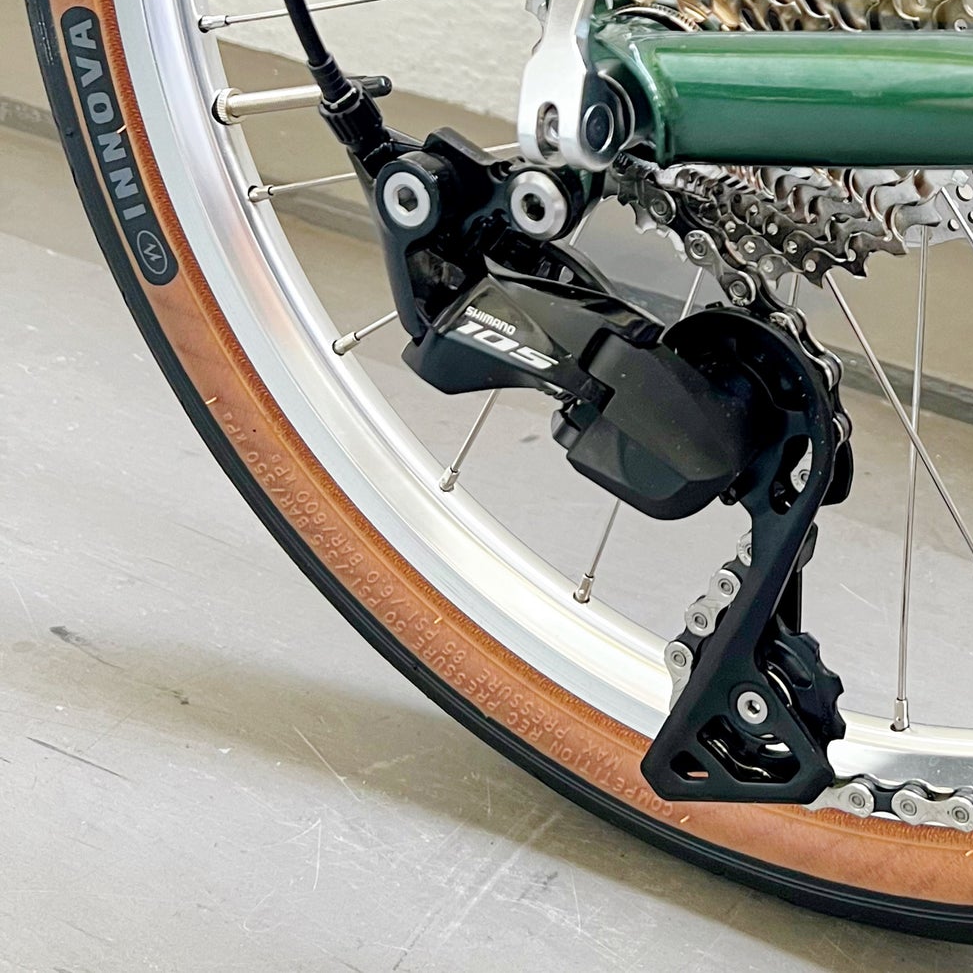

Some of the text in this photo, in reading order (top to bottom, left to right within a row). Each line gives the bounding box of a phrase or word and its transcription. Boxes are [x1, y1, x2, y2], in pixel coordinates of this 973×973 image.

[69, 18, 146, 221] INNOVA
[456, 320, 559, 369] 105
[465, 306, 517, 336] SHIMANO
[246, 451, 310, 528] BAR/350
[295, 490, 364, 566] BAR/600
[384, 611, 407, 633] 50
[442, 642, 466, 664] 85
[411, 638, 501, 711] PRESSURE
[475, 668, 569, 740] PRESSURE
[506, 712, 543, 741] REC
[550, 740, 673, 817] COMPETITION
